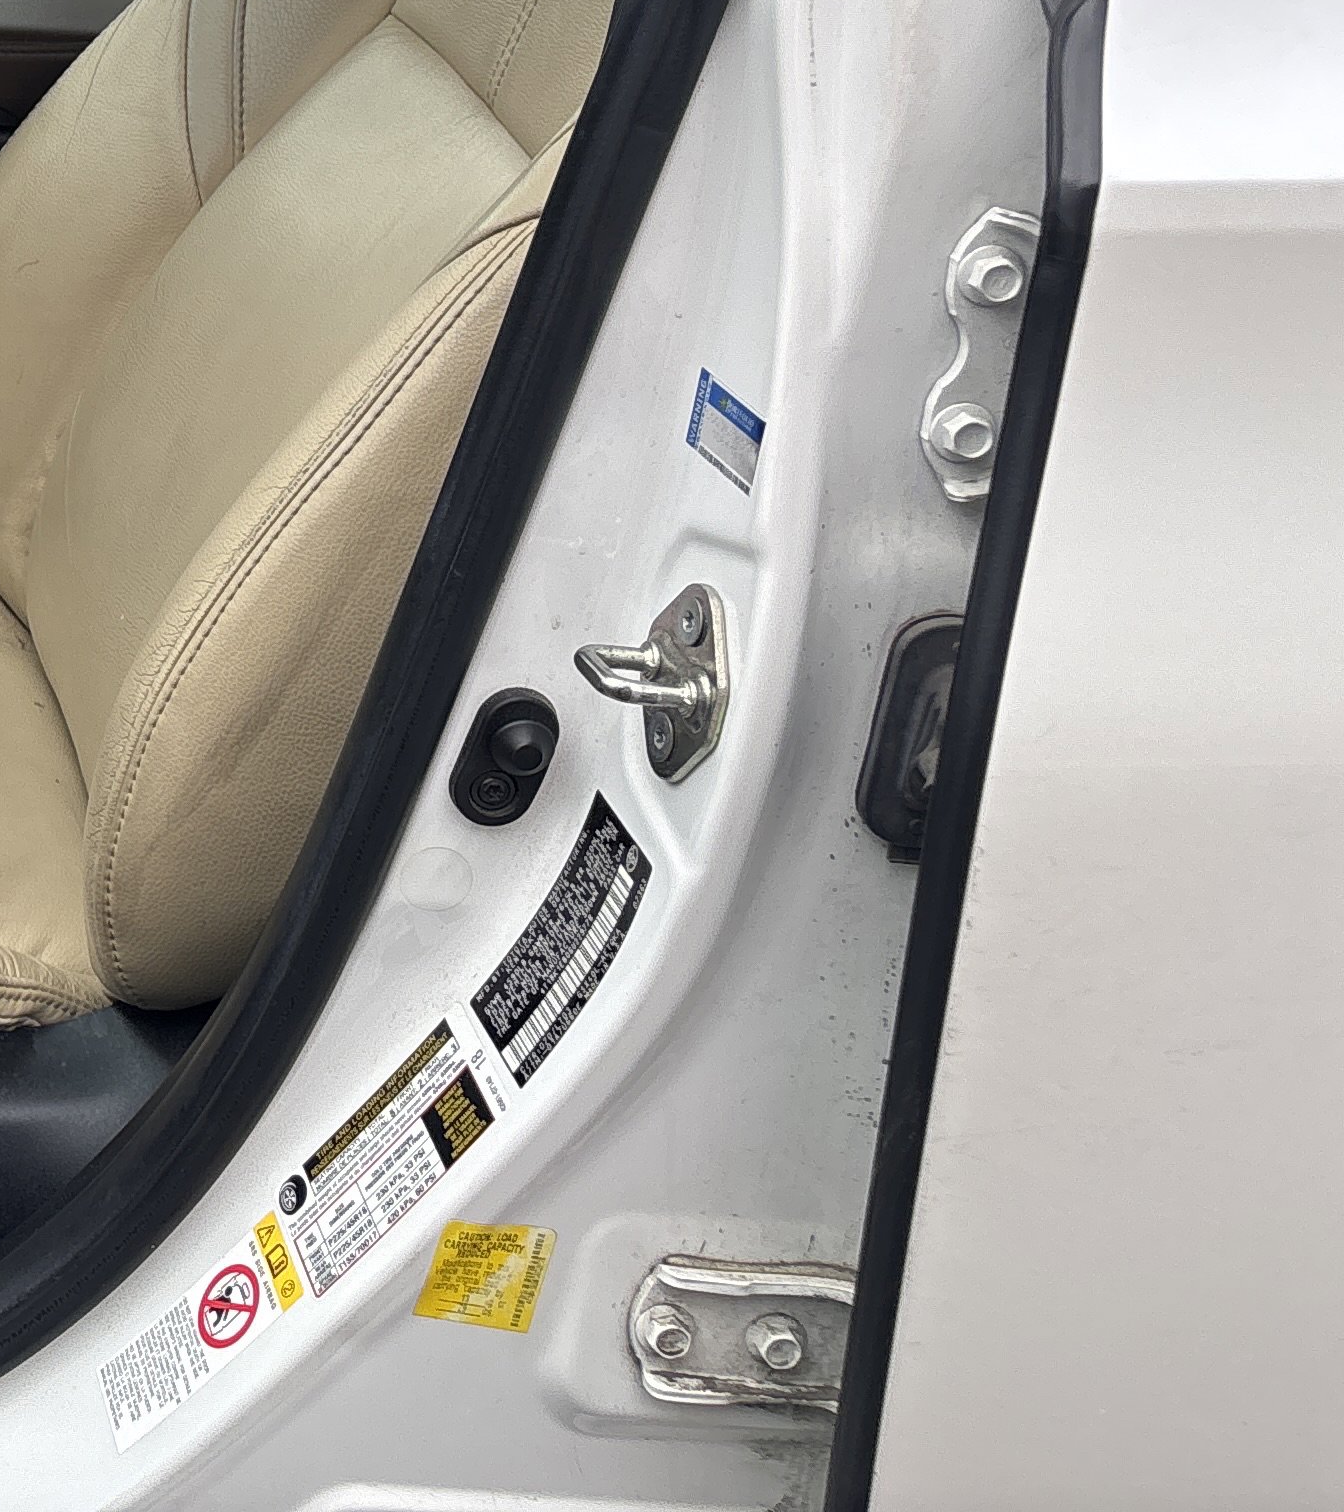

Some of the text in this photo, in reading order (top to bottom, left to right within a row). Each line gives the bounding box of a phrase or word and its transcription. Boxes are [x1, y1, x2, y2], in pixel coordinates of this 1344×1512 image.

[686, 378, 707, 445] WARNING
[471, 1049, 486, 1071] 18
[316, 1033, 437, 1161] TIRE AND LOADING INFORMATION
[412, 1146, 425, 1163] PSI
[418, 1158, 431, 1175] PSI
[423, 1170, 436, 1187] PSI
[497, 1232, 519, 1242] LOAD
[487, 1241, 525, 1254] CAPACITY
